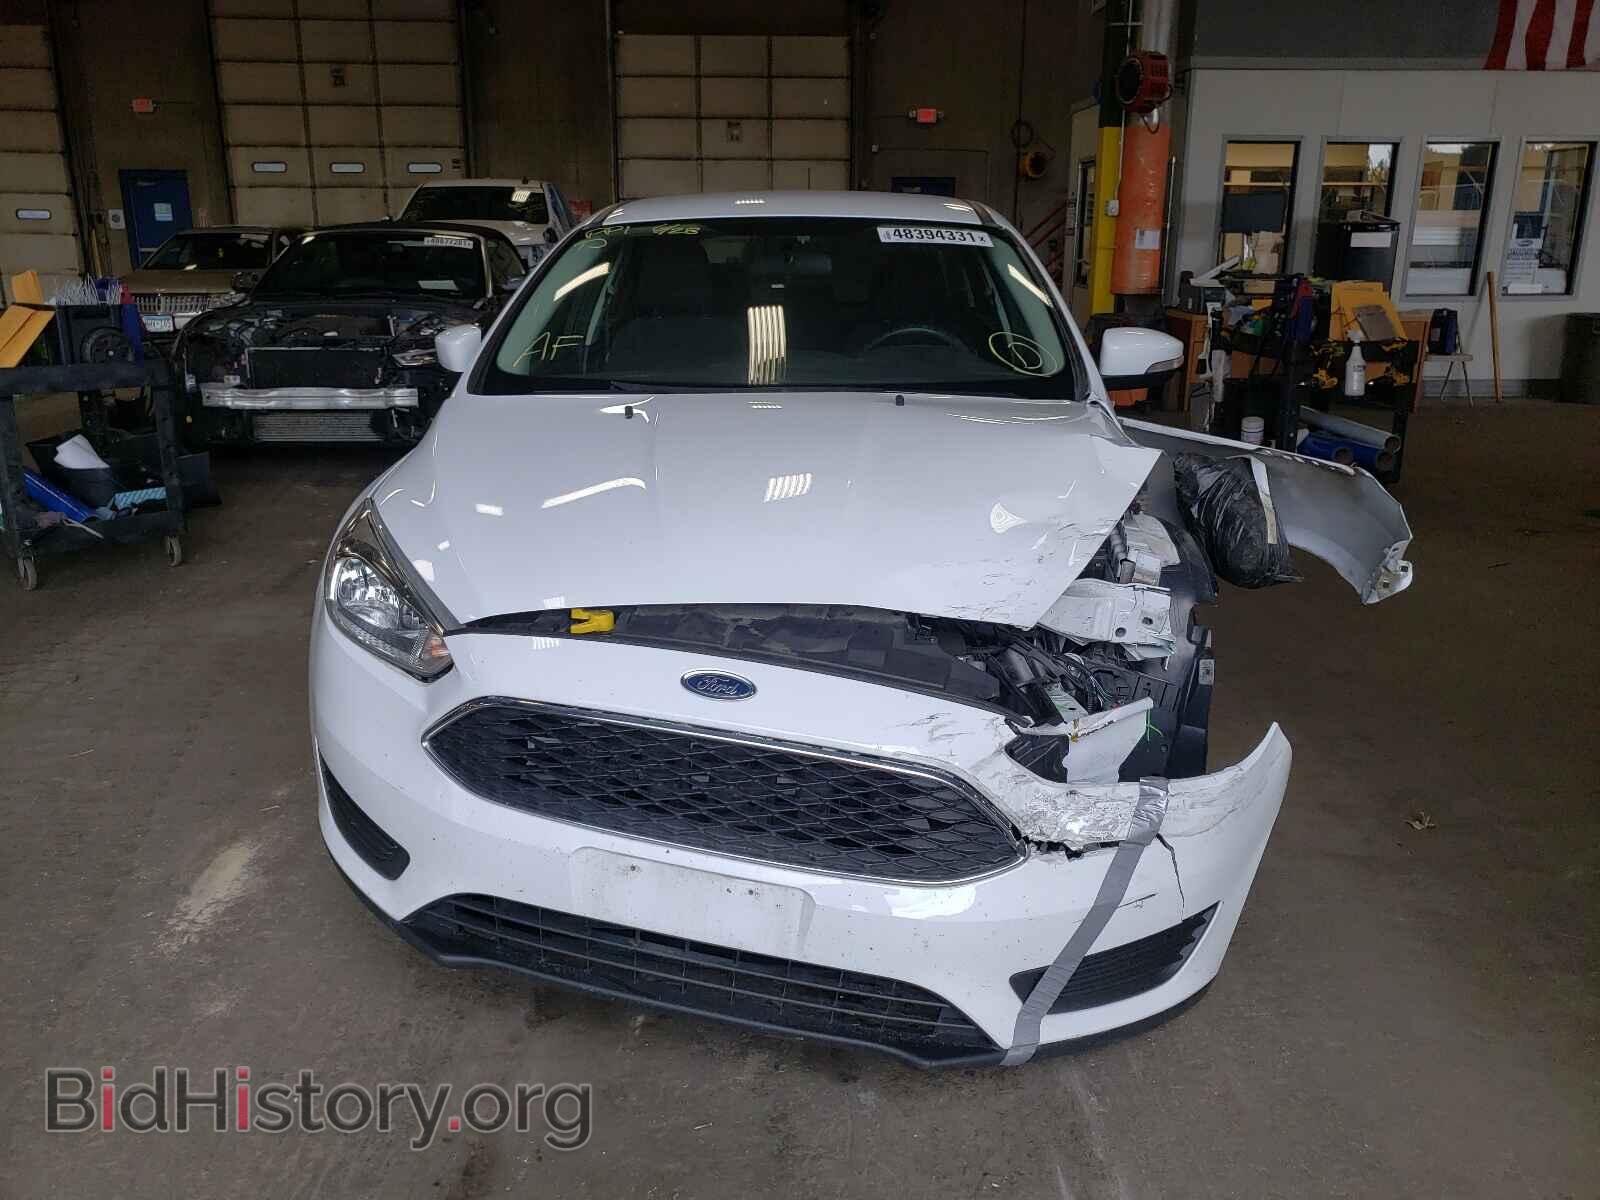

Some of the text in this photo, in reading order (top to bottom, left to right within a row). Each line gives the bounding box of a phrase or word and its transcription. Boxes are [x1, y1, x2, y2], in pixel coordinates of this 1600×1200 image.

[893, 228, 976, 243] 48394331
[512, 331, 584, 368] AF
[696, 677, 738, 695] Ford
